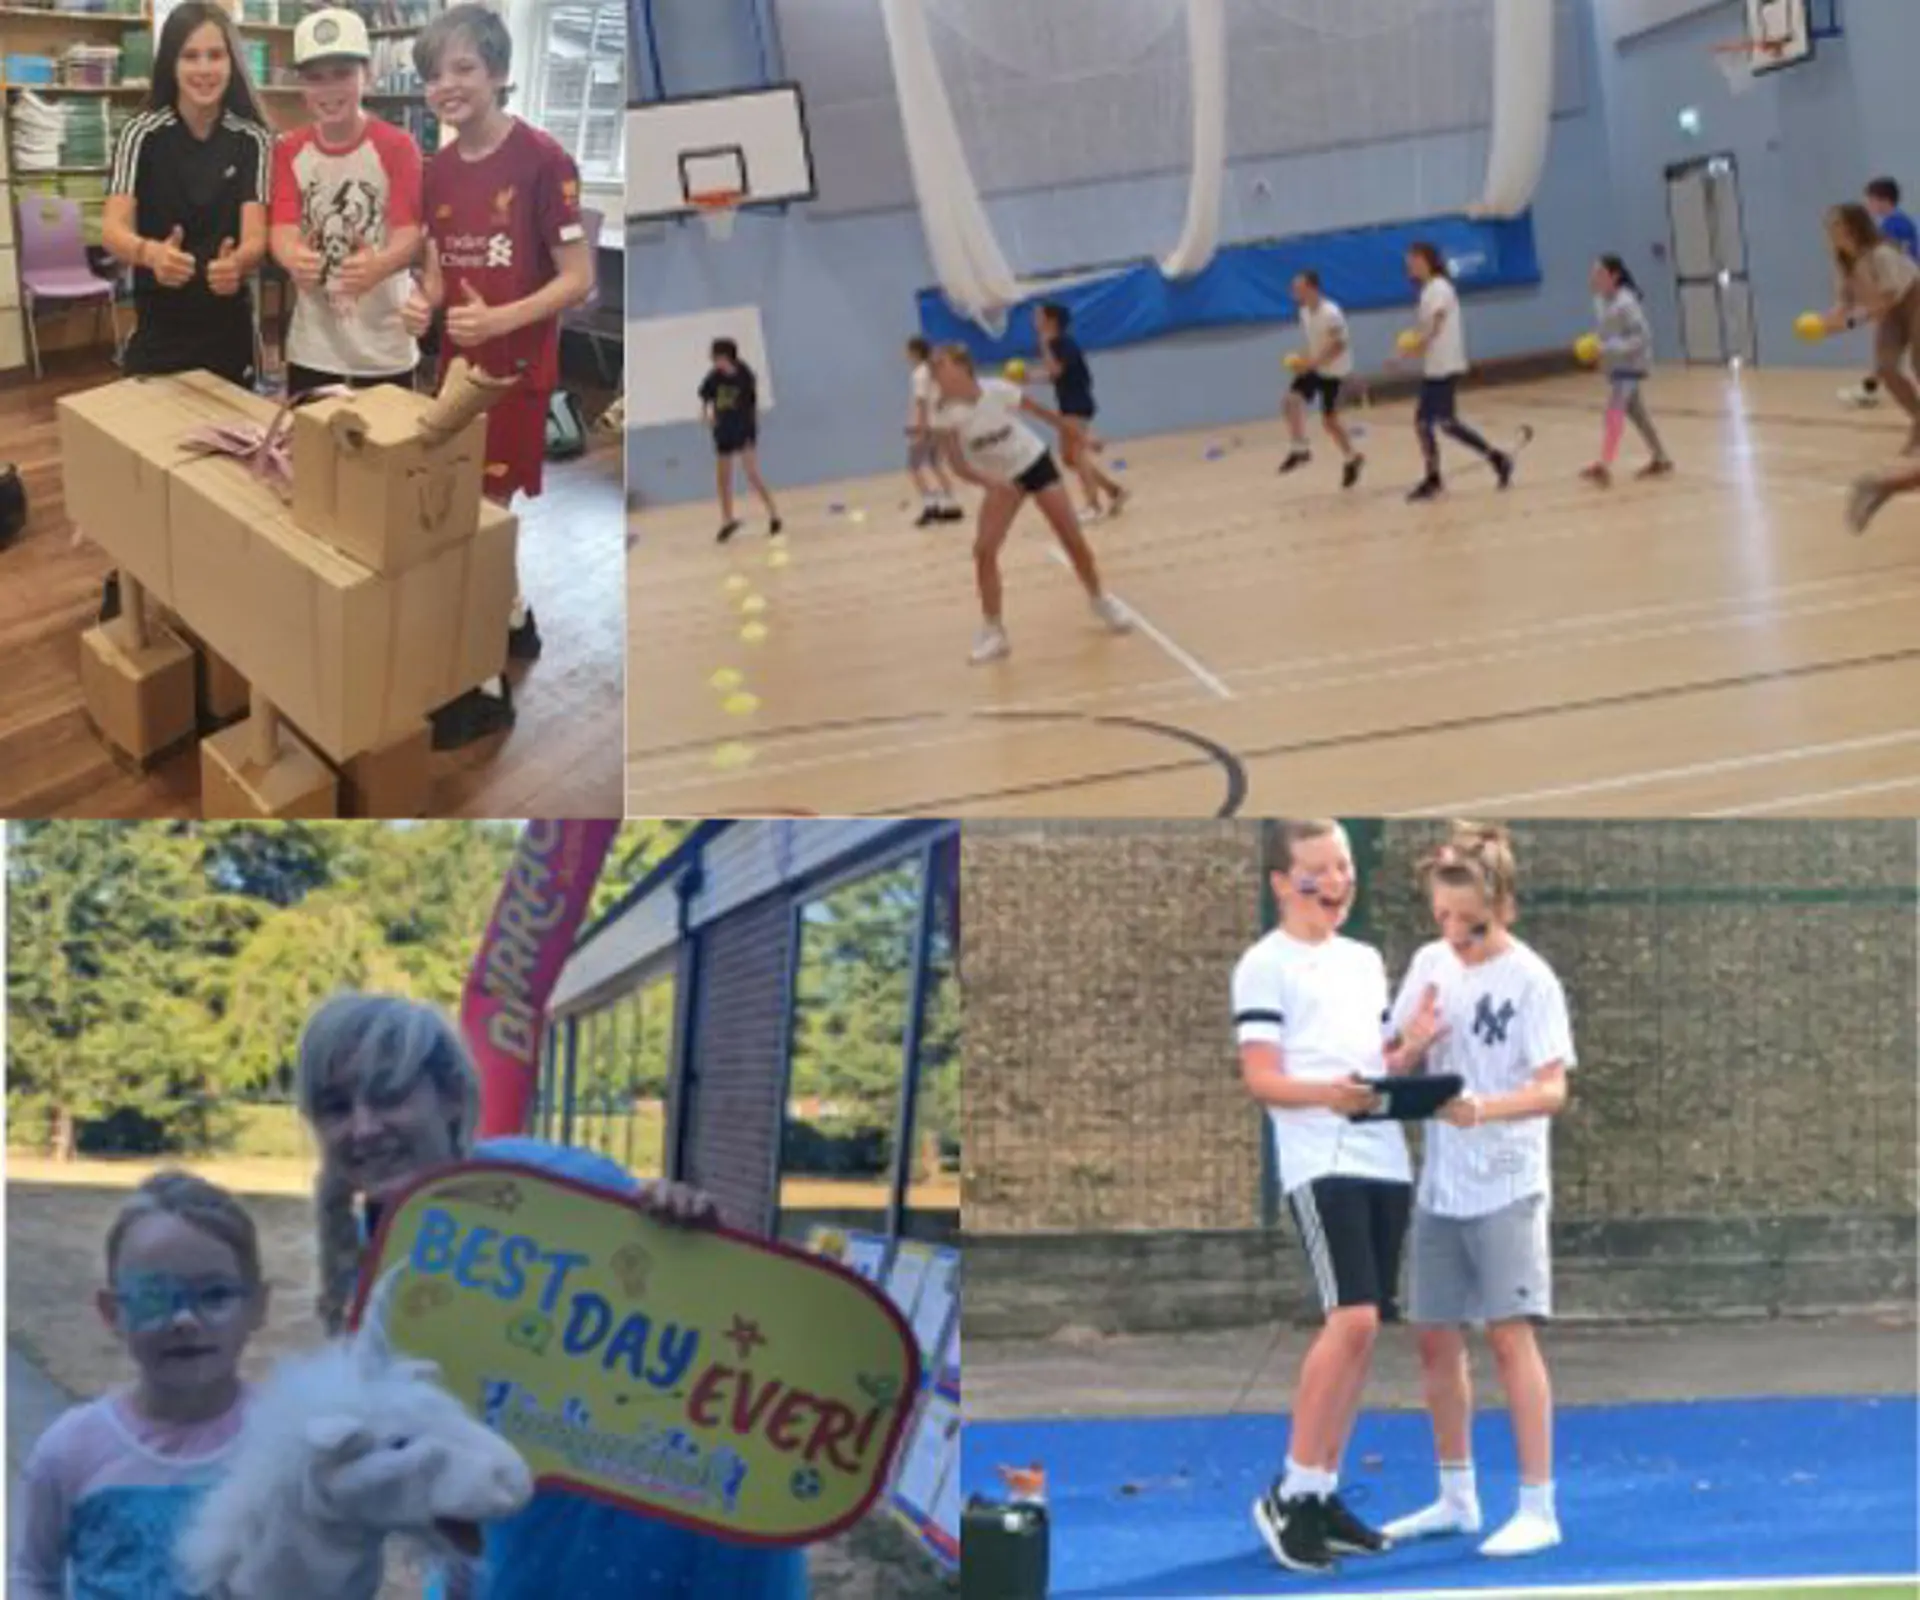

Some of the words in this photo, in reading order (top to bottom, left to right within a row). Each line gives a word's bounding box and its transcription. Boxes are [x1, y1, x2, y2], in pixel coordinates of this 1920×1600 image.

[410, 1208, 590, 1313] BEST
[564, 1291, 700, 1389] DAY
[689, 1361, 881, 1474] EVER!
